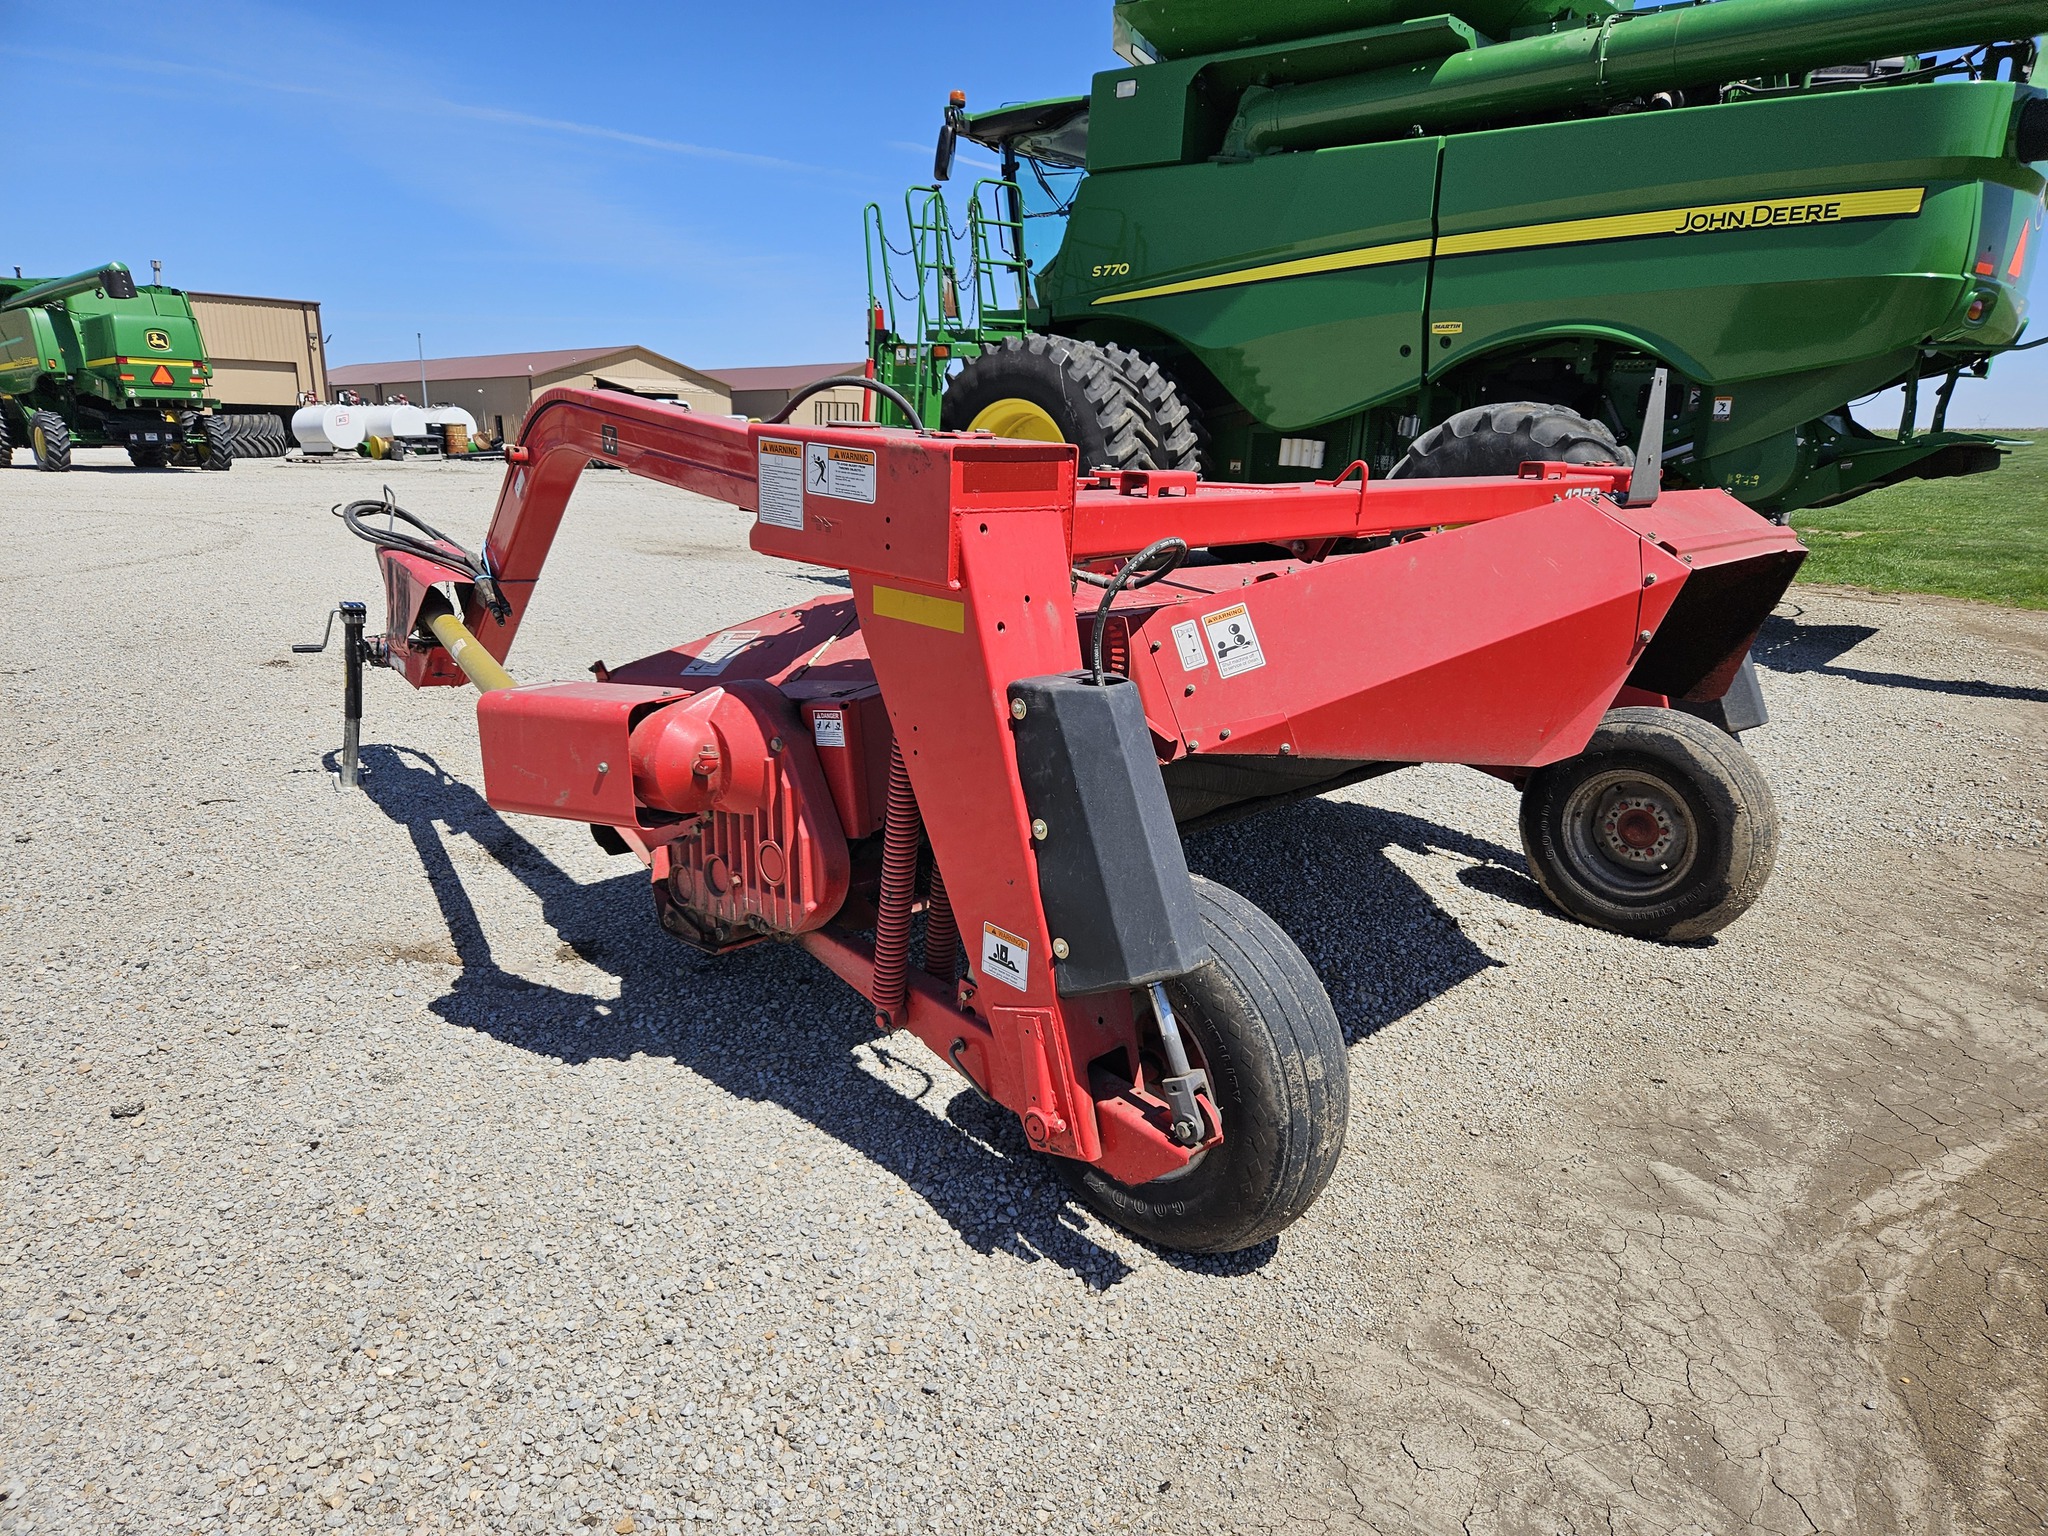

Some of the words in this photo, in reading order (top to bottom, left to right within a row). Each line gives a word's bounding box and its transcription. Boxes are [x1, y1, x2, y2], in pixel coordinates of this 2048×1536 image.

[1675, 211, 1746, 231] JOHN
[1751, 202, 1841, 225] DEERE
[1091, 262, 1130, 277] S770
[769, 444, 798, 456] WARNING
[840, 451, 869, 462] WARNING
[1212, 608, 1243, 622] WARNING
[997, 930, 1025, 948] WARNING
